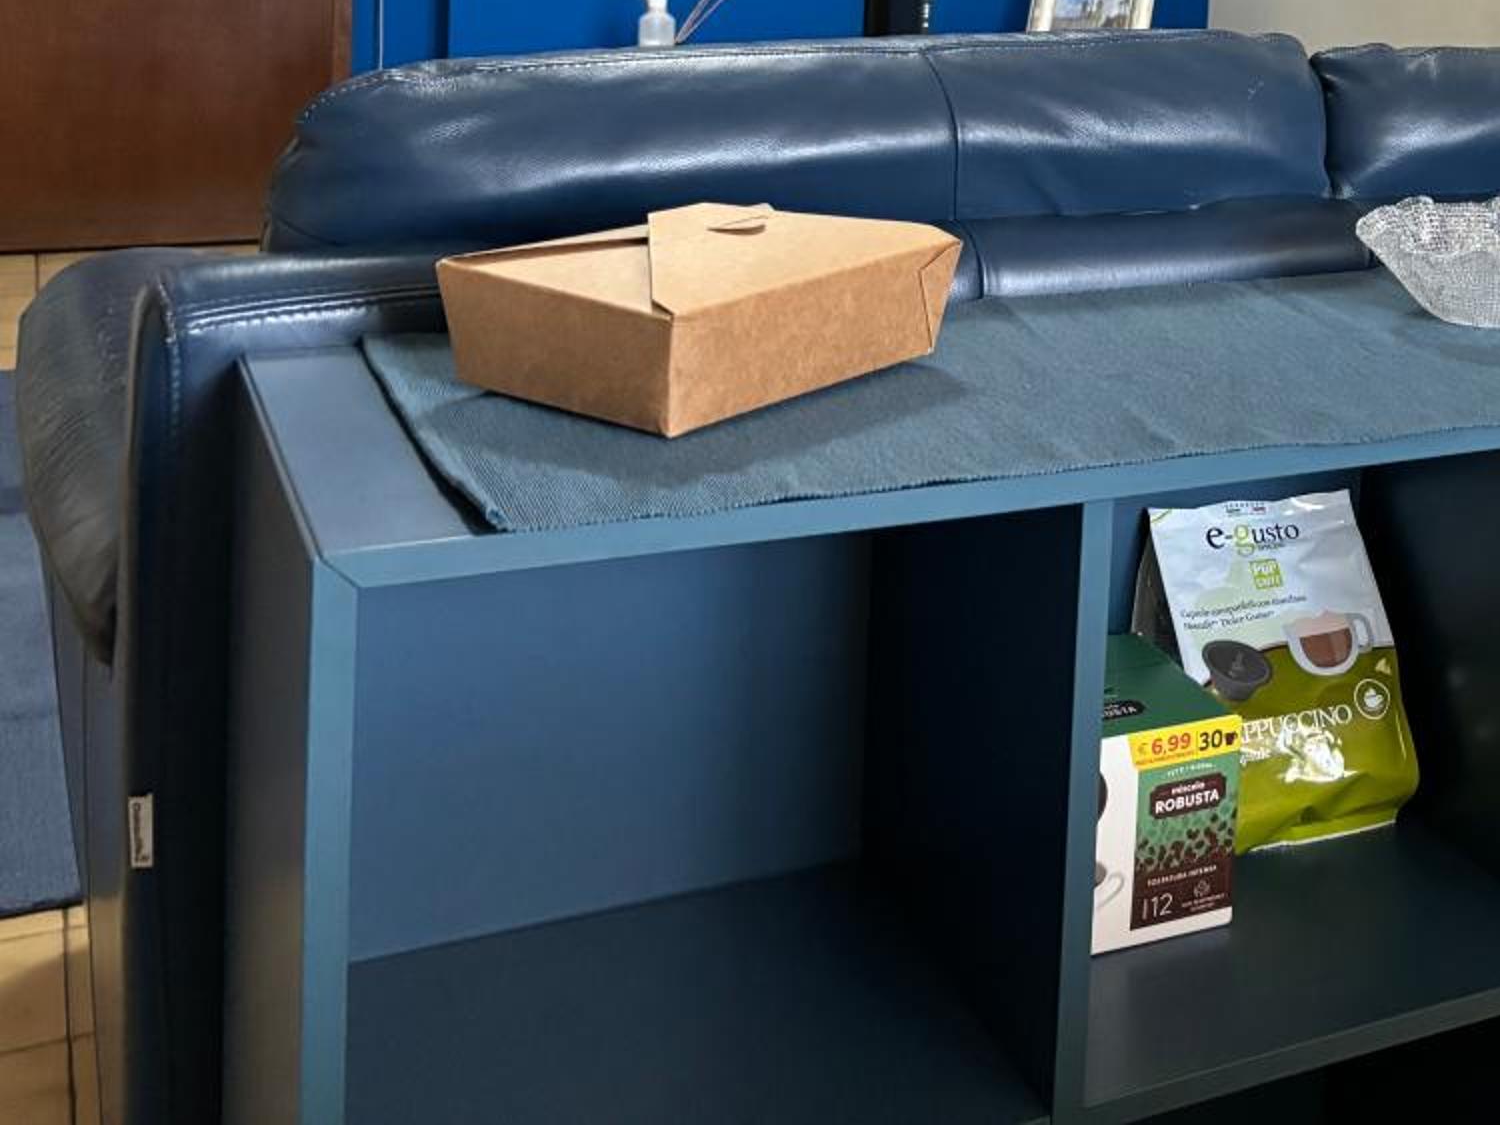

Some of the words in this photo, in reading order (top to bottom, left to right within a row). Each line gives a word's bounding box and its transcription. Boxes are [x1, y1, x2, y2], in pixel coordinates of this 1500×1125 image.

[1206, 521, 1300, 556] e-gusto
[1241, 704, 1352, 743] PPUCCINO
[1152, 732, 1191, 755] 6,99
[1199, 729, 1223, 751] 30
[1155, 790, 1220, 814] ROBUSTA
[1151, 892, 1173, 917] 12
